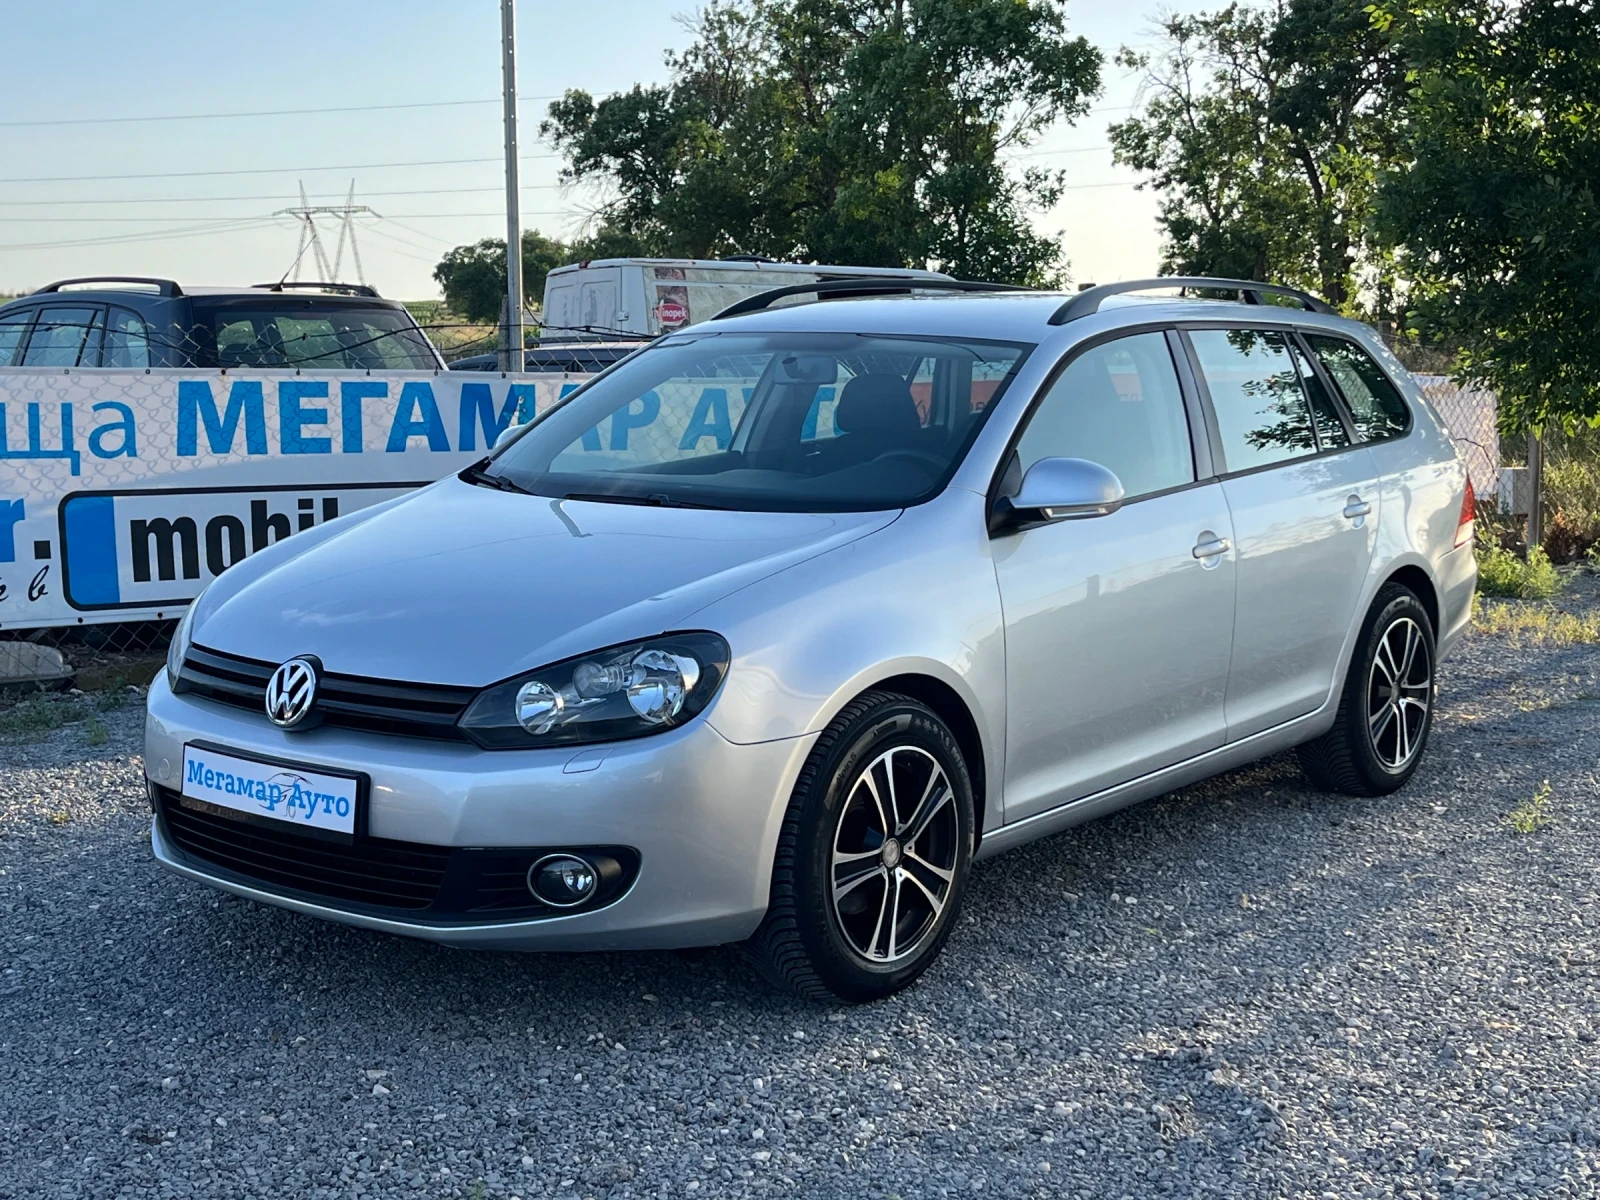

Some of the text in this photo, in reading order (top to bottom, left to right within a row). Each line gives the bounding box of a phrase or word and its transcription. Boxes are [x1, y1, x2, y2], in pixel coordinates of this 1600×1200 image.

[130, 497, 338, 582] mob
[187, 759, 282, 811] Мегамар
[288, 783, 350, 819] Ауто
